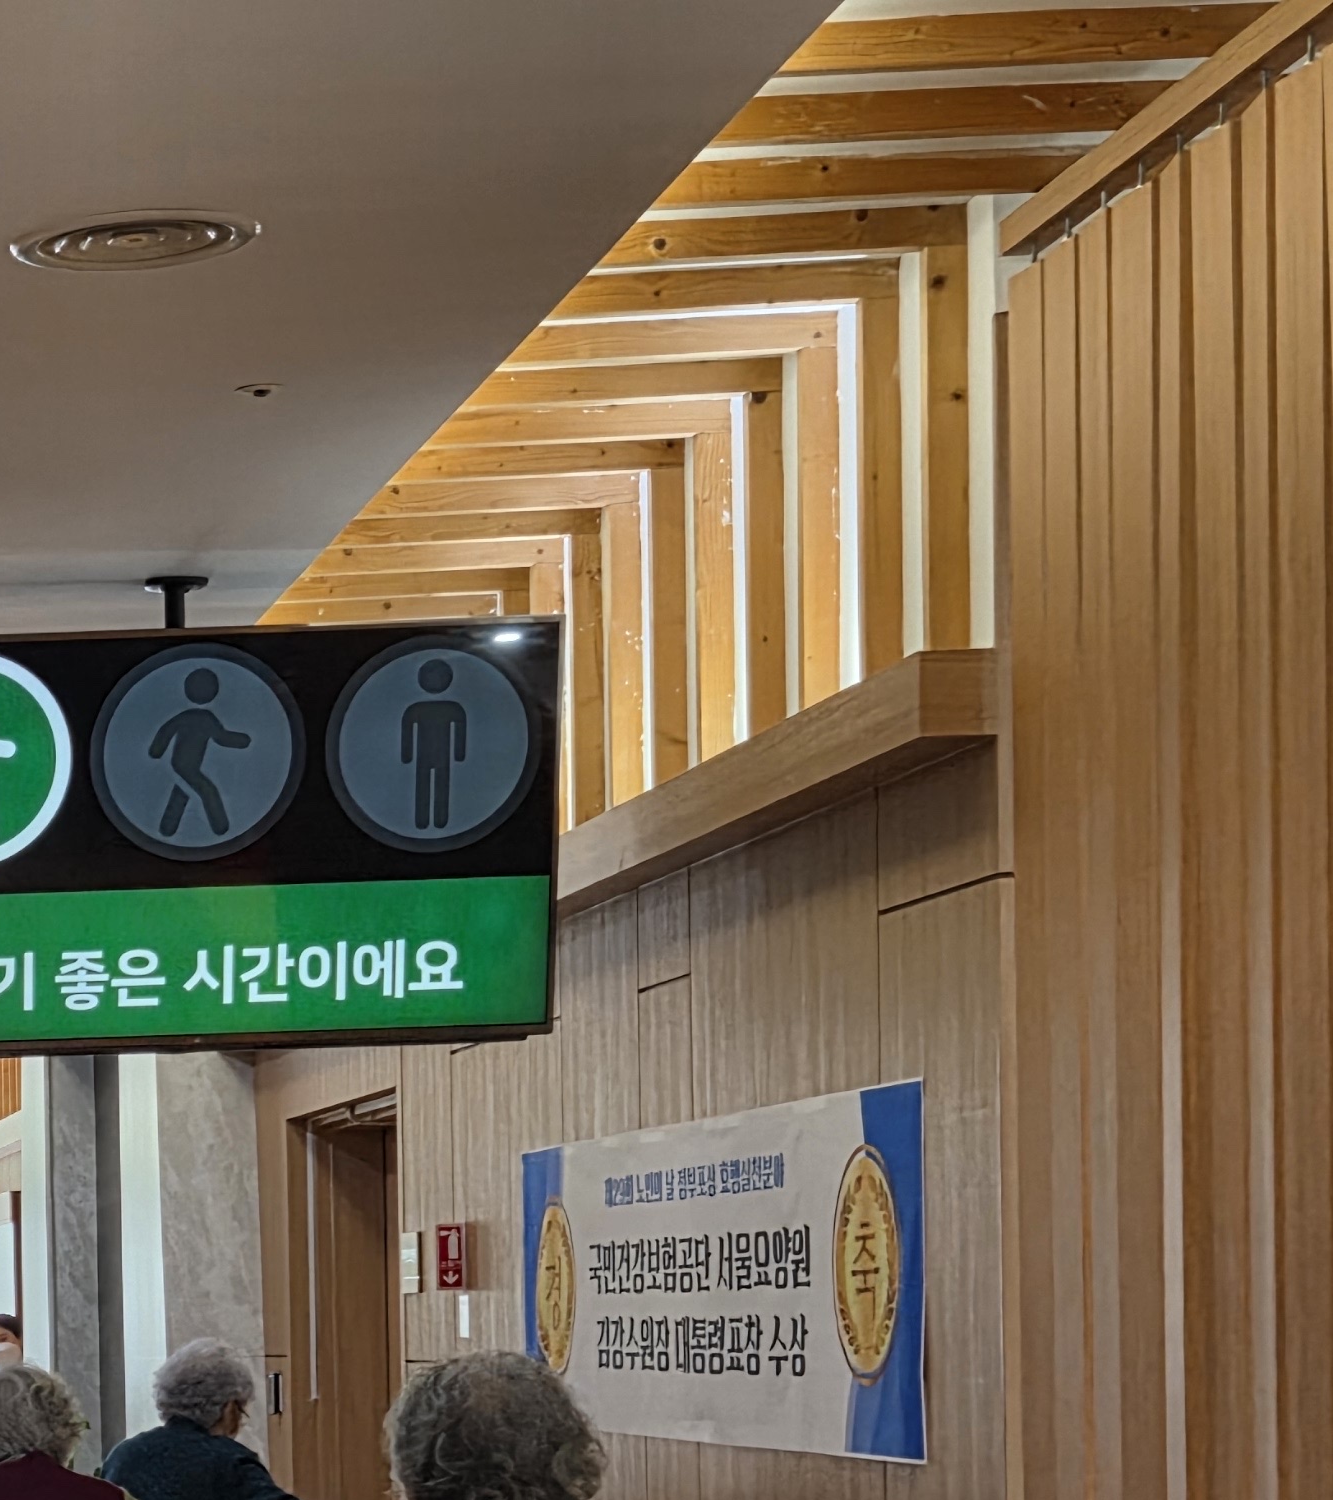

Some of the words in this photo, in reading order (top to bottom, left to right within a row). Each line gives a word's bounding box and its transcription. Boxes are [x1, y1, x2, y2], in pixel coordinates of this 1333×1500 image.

[54, 947, 167, 1012] 좋은
[182, 938, 465, 1006] 시간이에요
[589, 1233, 712, 1295] 국민건강보험공단
[717, 1223, 811, 1292] 서울요양원
[596, 1315, 670, 1372] 김강수원장
[675, 1314, 764, 1375] 대통령표창
[768, 1313, 810, 1377] 수상
